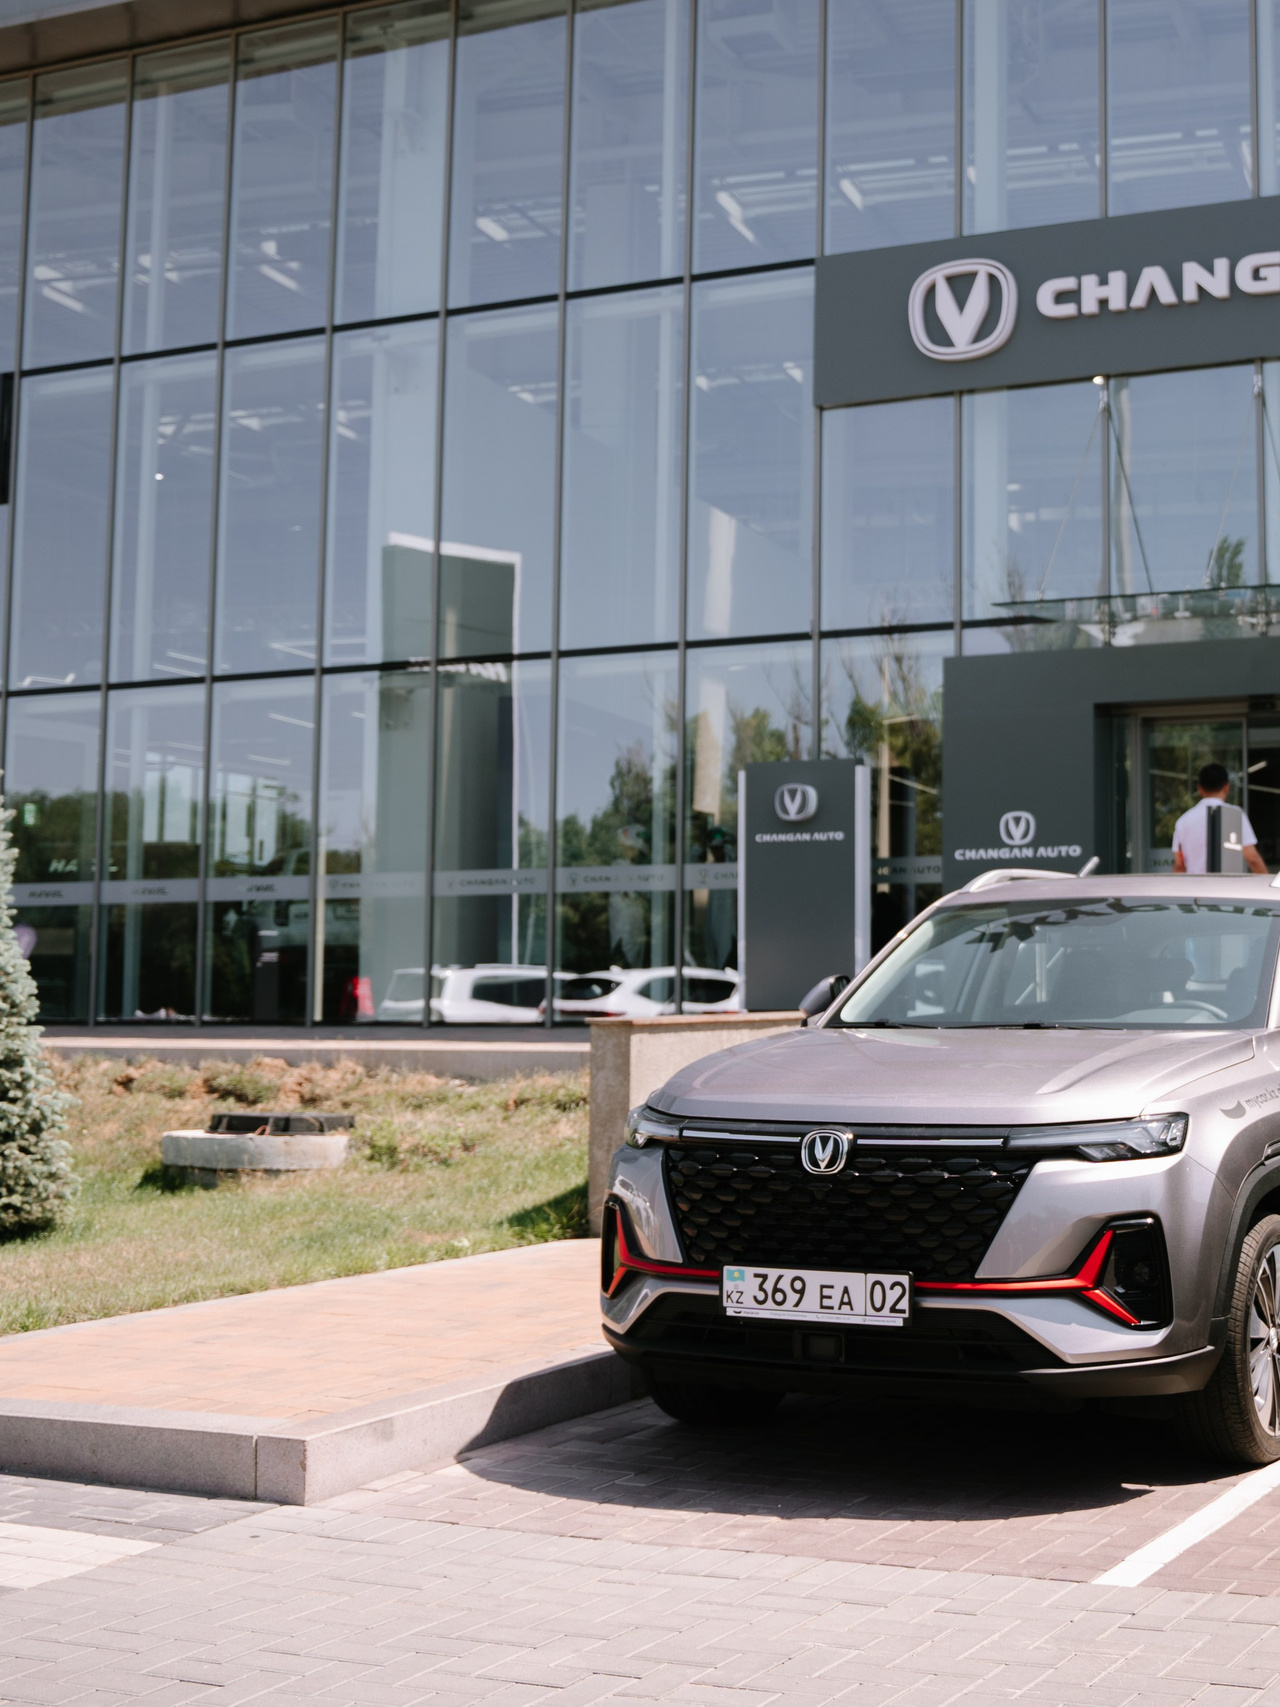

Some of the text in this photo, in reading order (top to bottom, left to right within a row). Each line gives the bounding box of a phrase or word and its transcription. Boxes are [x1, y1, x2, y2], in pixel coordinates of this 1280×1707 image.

[755, 831, 846, 843] CHANGAN AUTO
[954, 845, 1082, 860] CHANGAN AUTO
[1245, 1088, 1279, 1108] mycar.kz
[726, 1273, 907, 1314] KZ 369 EA 02
